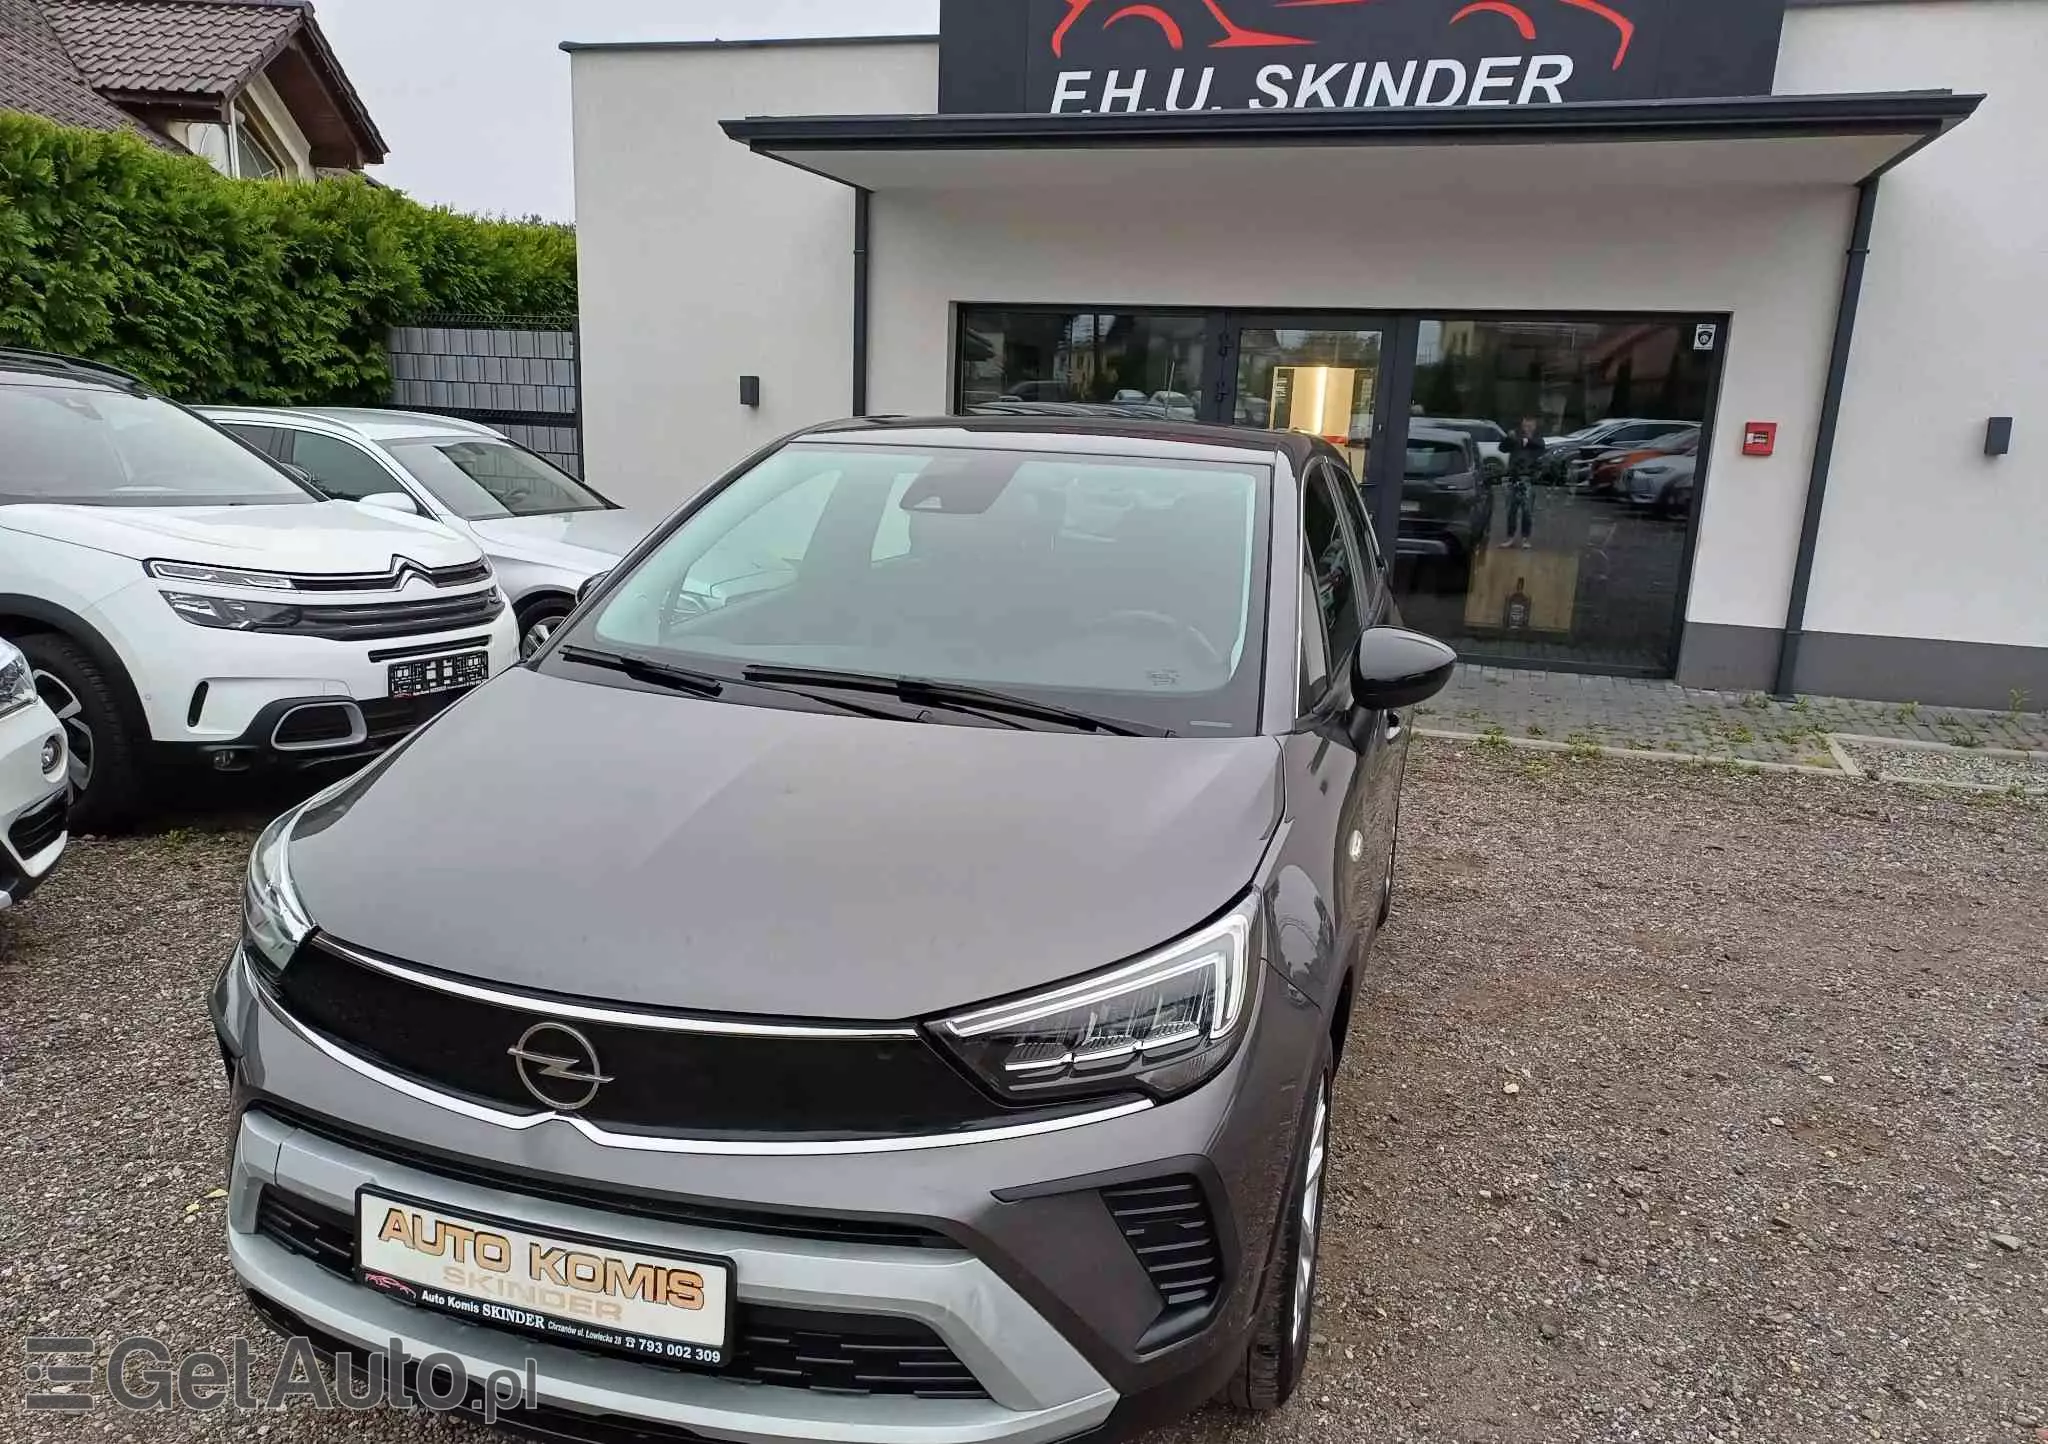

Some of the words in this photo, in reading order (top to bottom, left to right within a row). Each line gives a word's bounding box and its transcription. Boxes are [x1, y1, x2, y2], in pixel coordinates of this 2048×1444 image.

[1050, 67, 1222, 114] F.H.U.
[1249, 54, 1574, 111] SKINDER
[378, 1207, 511, 1273] AUTO
[529, 1242, 704, 1311] KOMIS
[421, 1290, 445, 1305] Auto
[447, 1296, 479, 1313] Komis
[482, 1303, 545, 1329] SKINDER
[638, 1338, 662, 1353] 793
[666, 1343, 691, 1358] 002
[695, 1348, 721, 1363] 309
[443, 1265, 623, 1322] SKINDER
